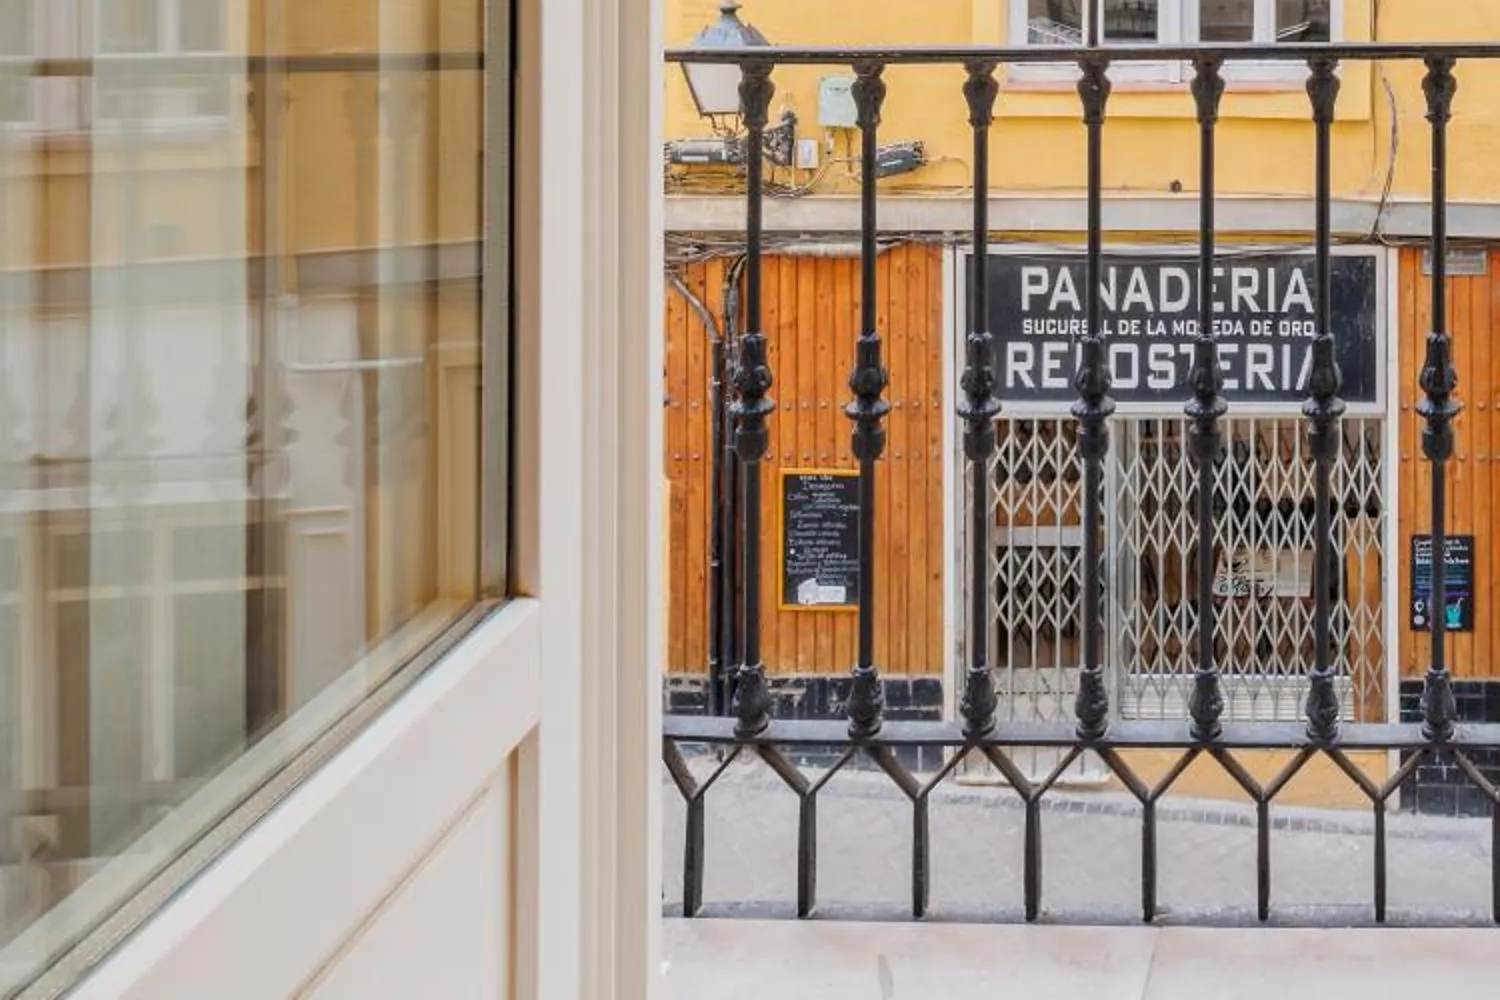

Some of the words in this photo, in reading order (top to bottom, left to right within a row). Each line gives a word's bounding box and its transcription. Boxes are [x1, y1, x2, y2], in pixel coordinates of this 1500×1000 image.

[1021, 266, 1314, 313] PANADERIA
[1023, 318, 1112, 335] SUCURSL
[1118, 320, 1140, 335] DE
[1146, 319, 1166, 335] LA
[1173, 320, 1244, 336] MOEDA
[1251, 321, 1272, 336] DE
[1279, 321, 1315, 336] ORO
[1006, 341, 1313, 391] REOSERI
